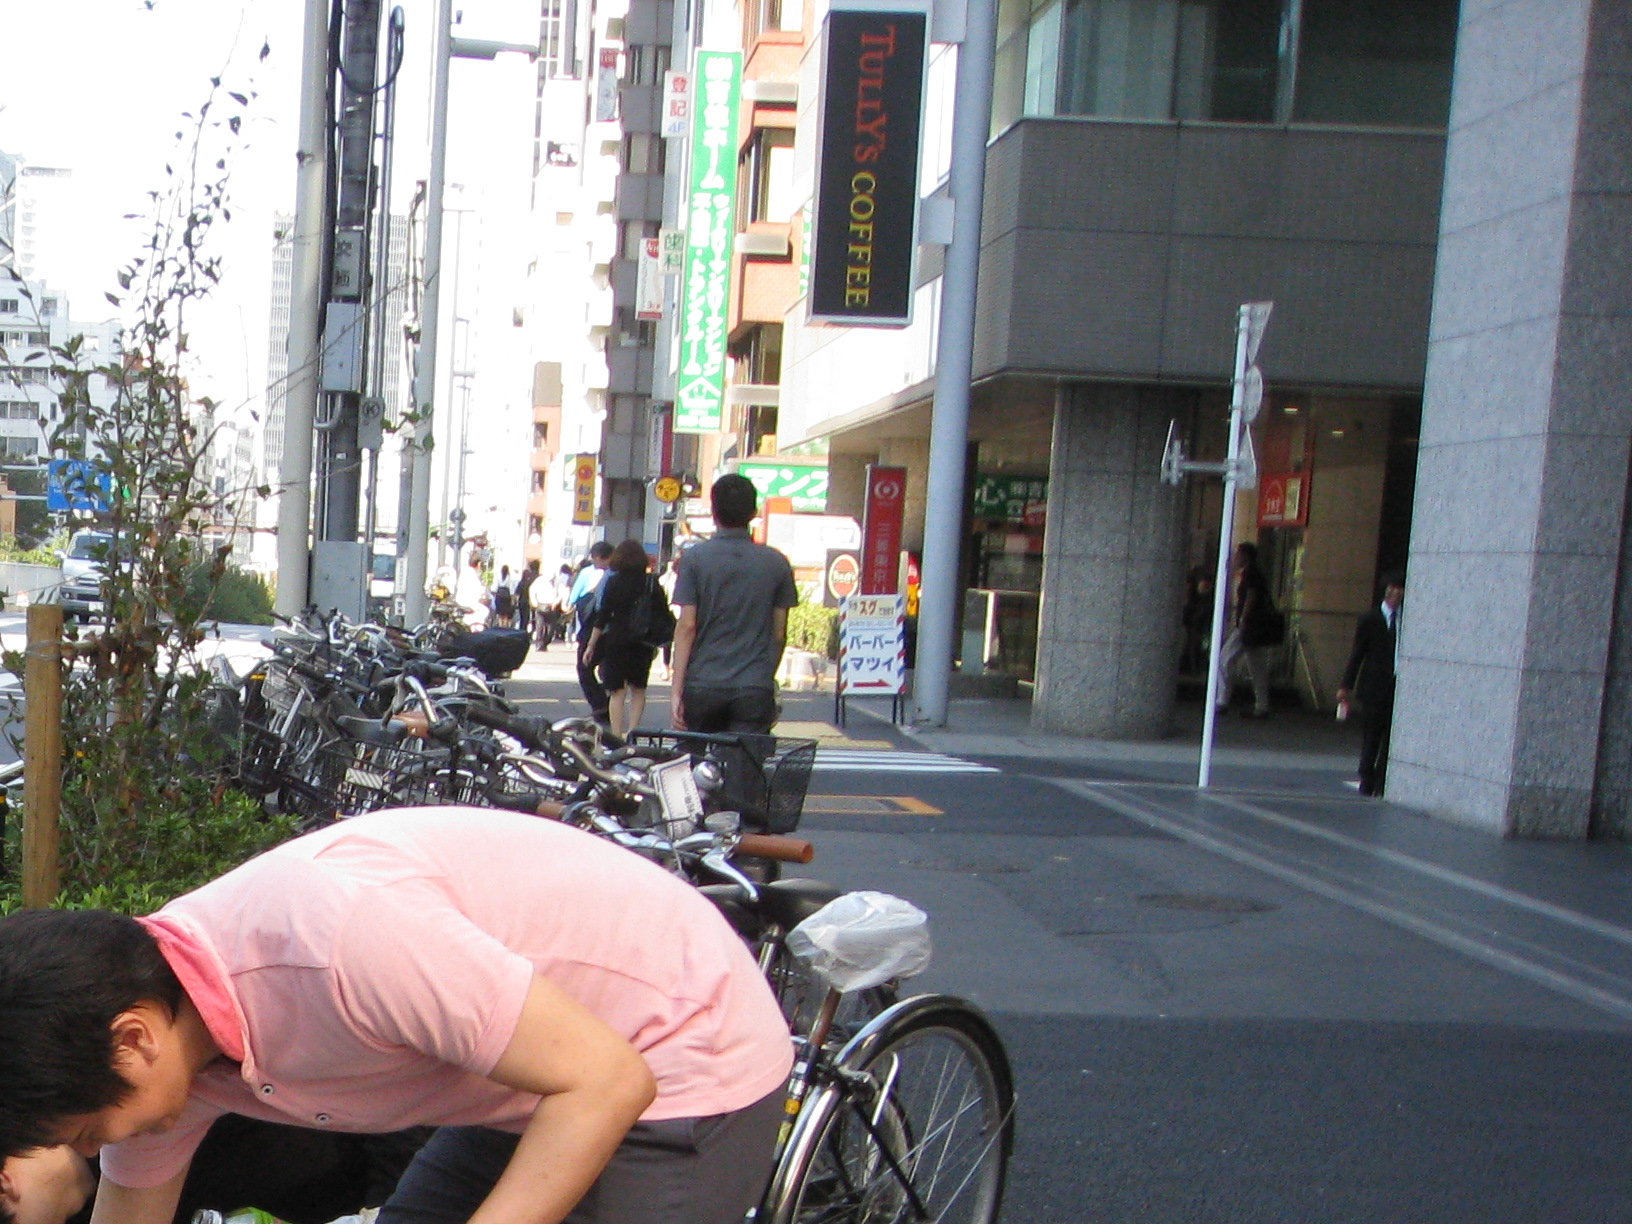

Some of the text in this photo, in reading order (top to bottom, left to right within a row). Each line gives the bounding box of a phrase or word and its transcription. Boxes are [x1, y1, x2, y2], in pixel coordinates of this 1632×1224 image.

[670, 76, 688, 117] 登記
[845, 24, 897, 308] TULLY'S COFFEE
[849, 634, 895, 650] バーバー
[849, 657, 895, 672] マツイ
